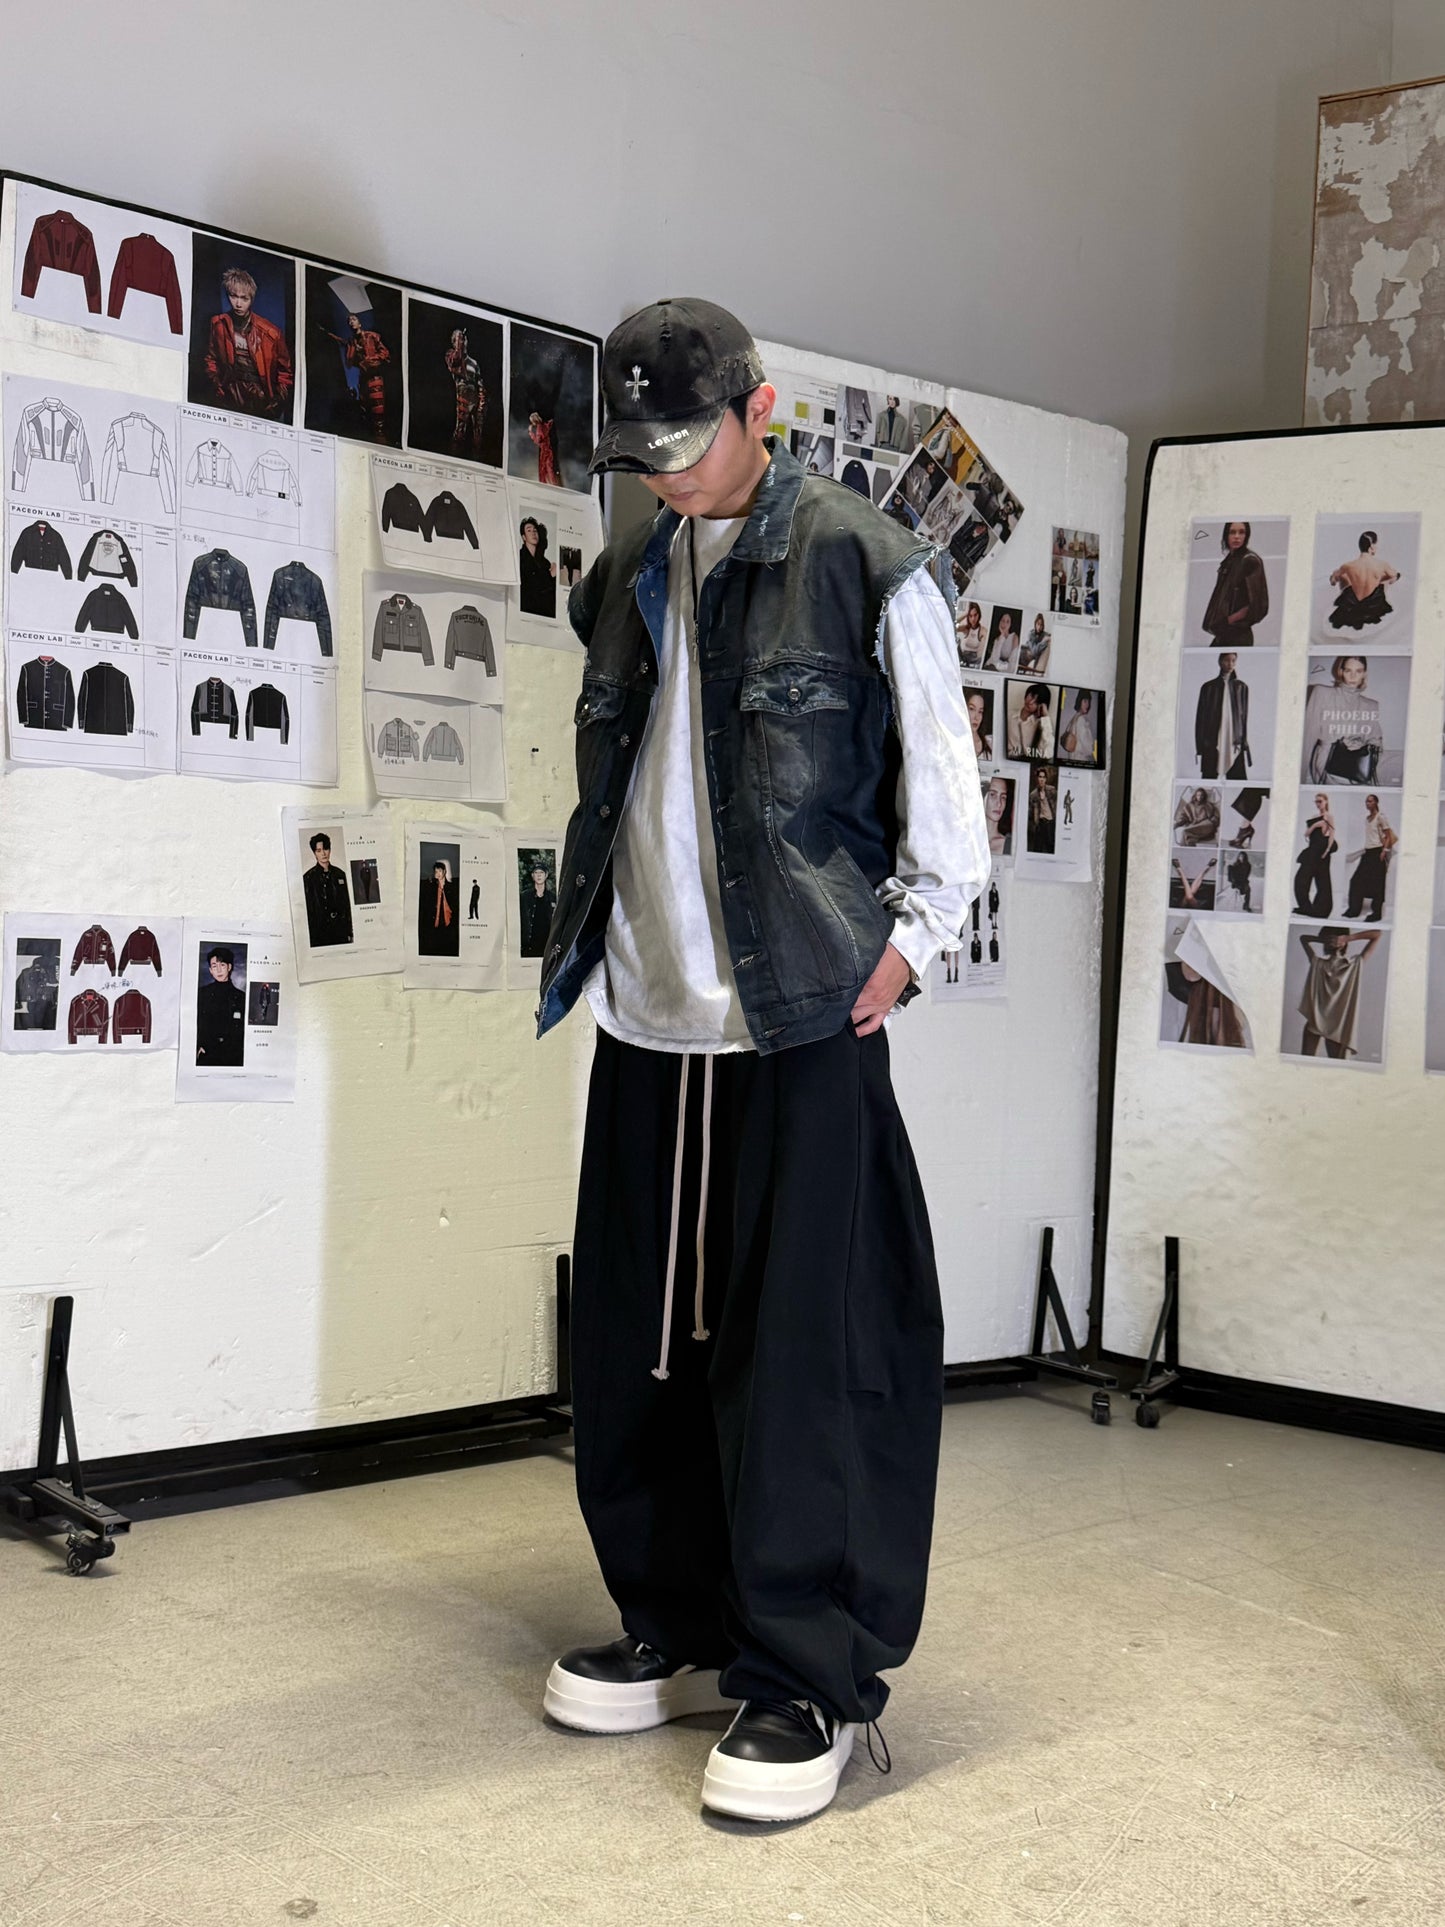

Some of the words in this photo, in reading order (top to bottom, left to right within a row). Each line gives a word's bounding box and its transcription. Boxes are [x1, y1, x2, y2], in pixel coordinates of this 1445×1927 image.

[182, 409, 212, 420] FACEON
[213, 414, 228, 423] LAB
[11, 505, 44, 516] FACEON
[46, 510, 62, 518] LAB
[11, 631, 45, 641] FACEON
[183, 652, 213, 661] FACEON
[1322, 710, 1380, 721] PHOEBE
[1328, 723, 1372, 735] PHILO
